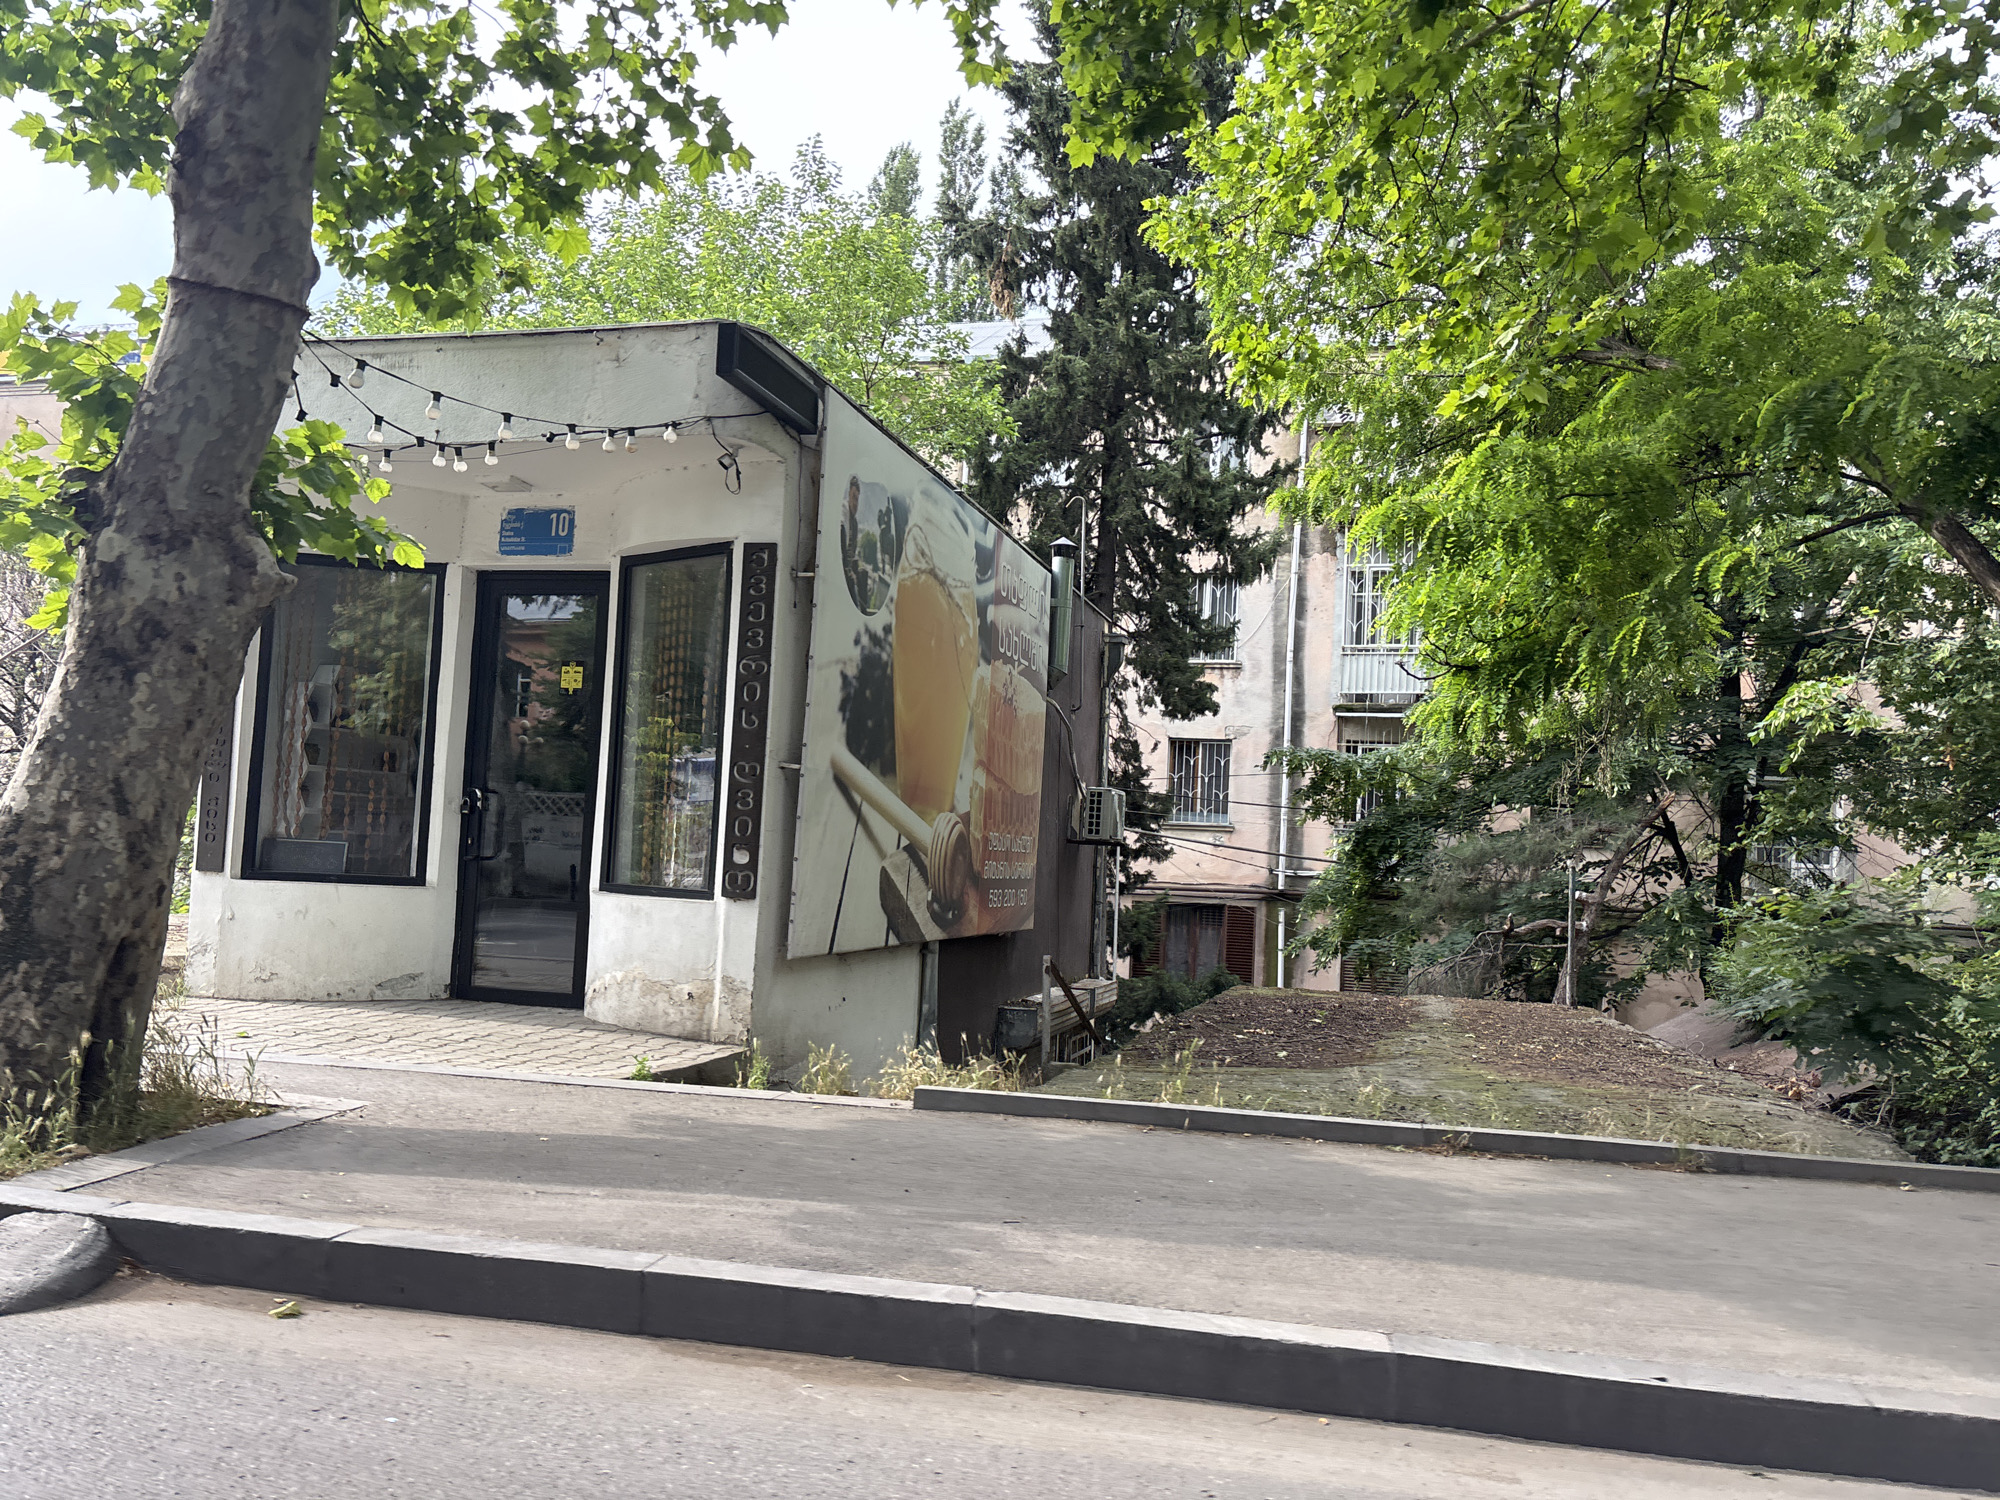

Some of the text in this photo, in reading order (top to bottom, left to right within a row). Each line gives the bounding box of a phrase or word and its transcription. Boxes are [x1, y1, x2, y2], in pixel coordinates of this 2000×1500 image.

[1000, 561, 1046, 625] თაფლი
[998, 616, 1044, 675] სახლში
[989, 889, 1002, 908] 593
[1003, 888, 1016, 907] 200
